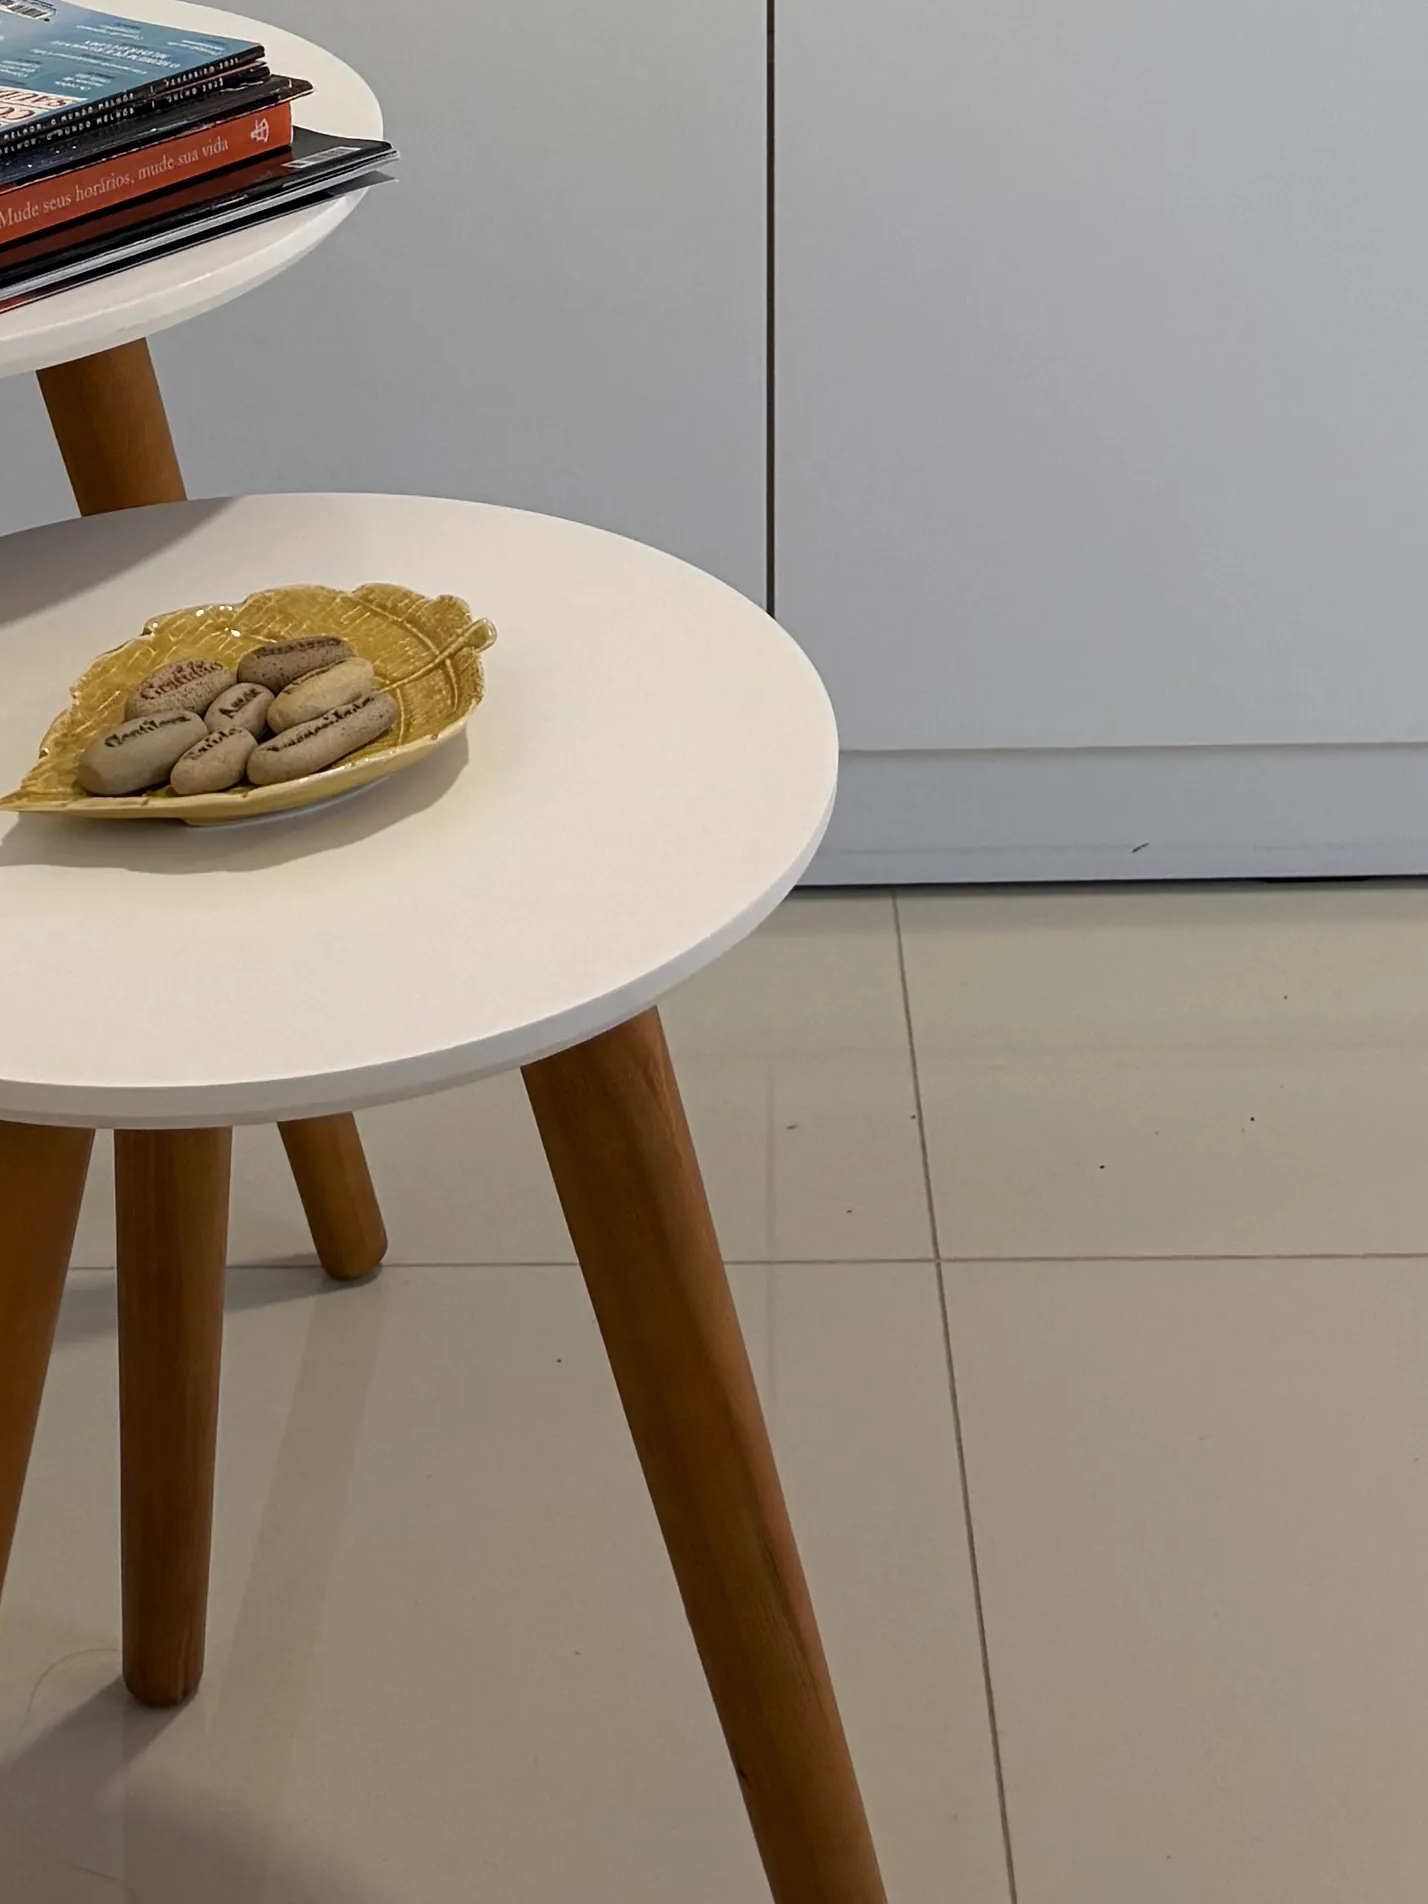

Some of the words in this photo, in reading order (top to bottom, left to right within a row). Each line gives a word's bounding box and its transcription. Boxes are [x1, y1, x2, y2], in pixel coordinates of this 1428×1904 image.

[42, 195, 72, 214] seus
[138, 158, 174, 180] mude
[177, 150, 198, 166] sua
[202, 136, 229, 157] vida
